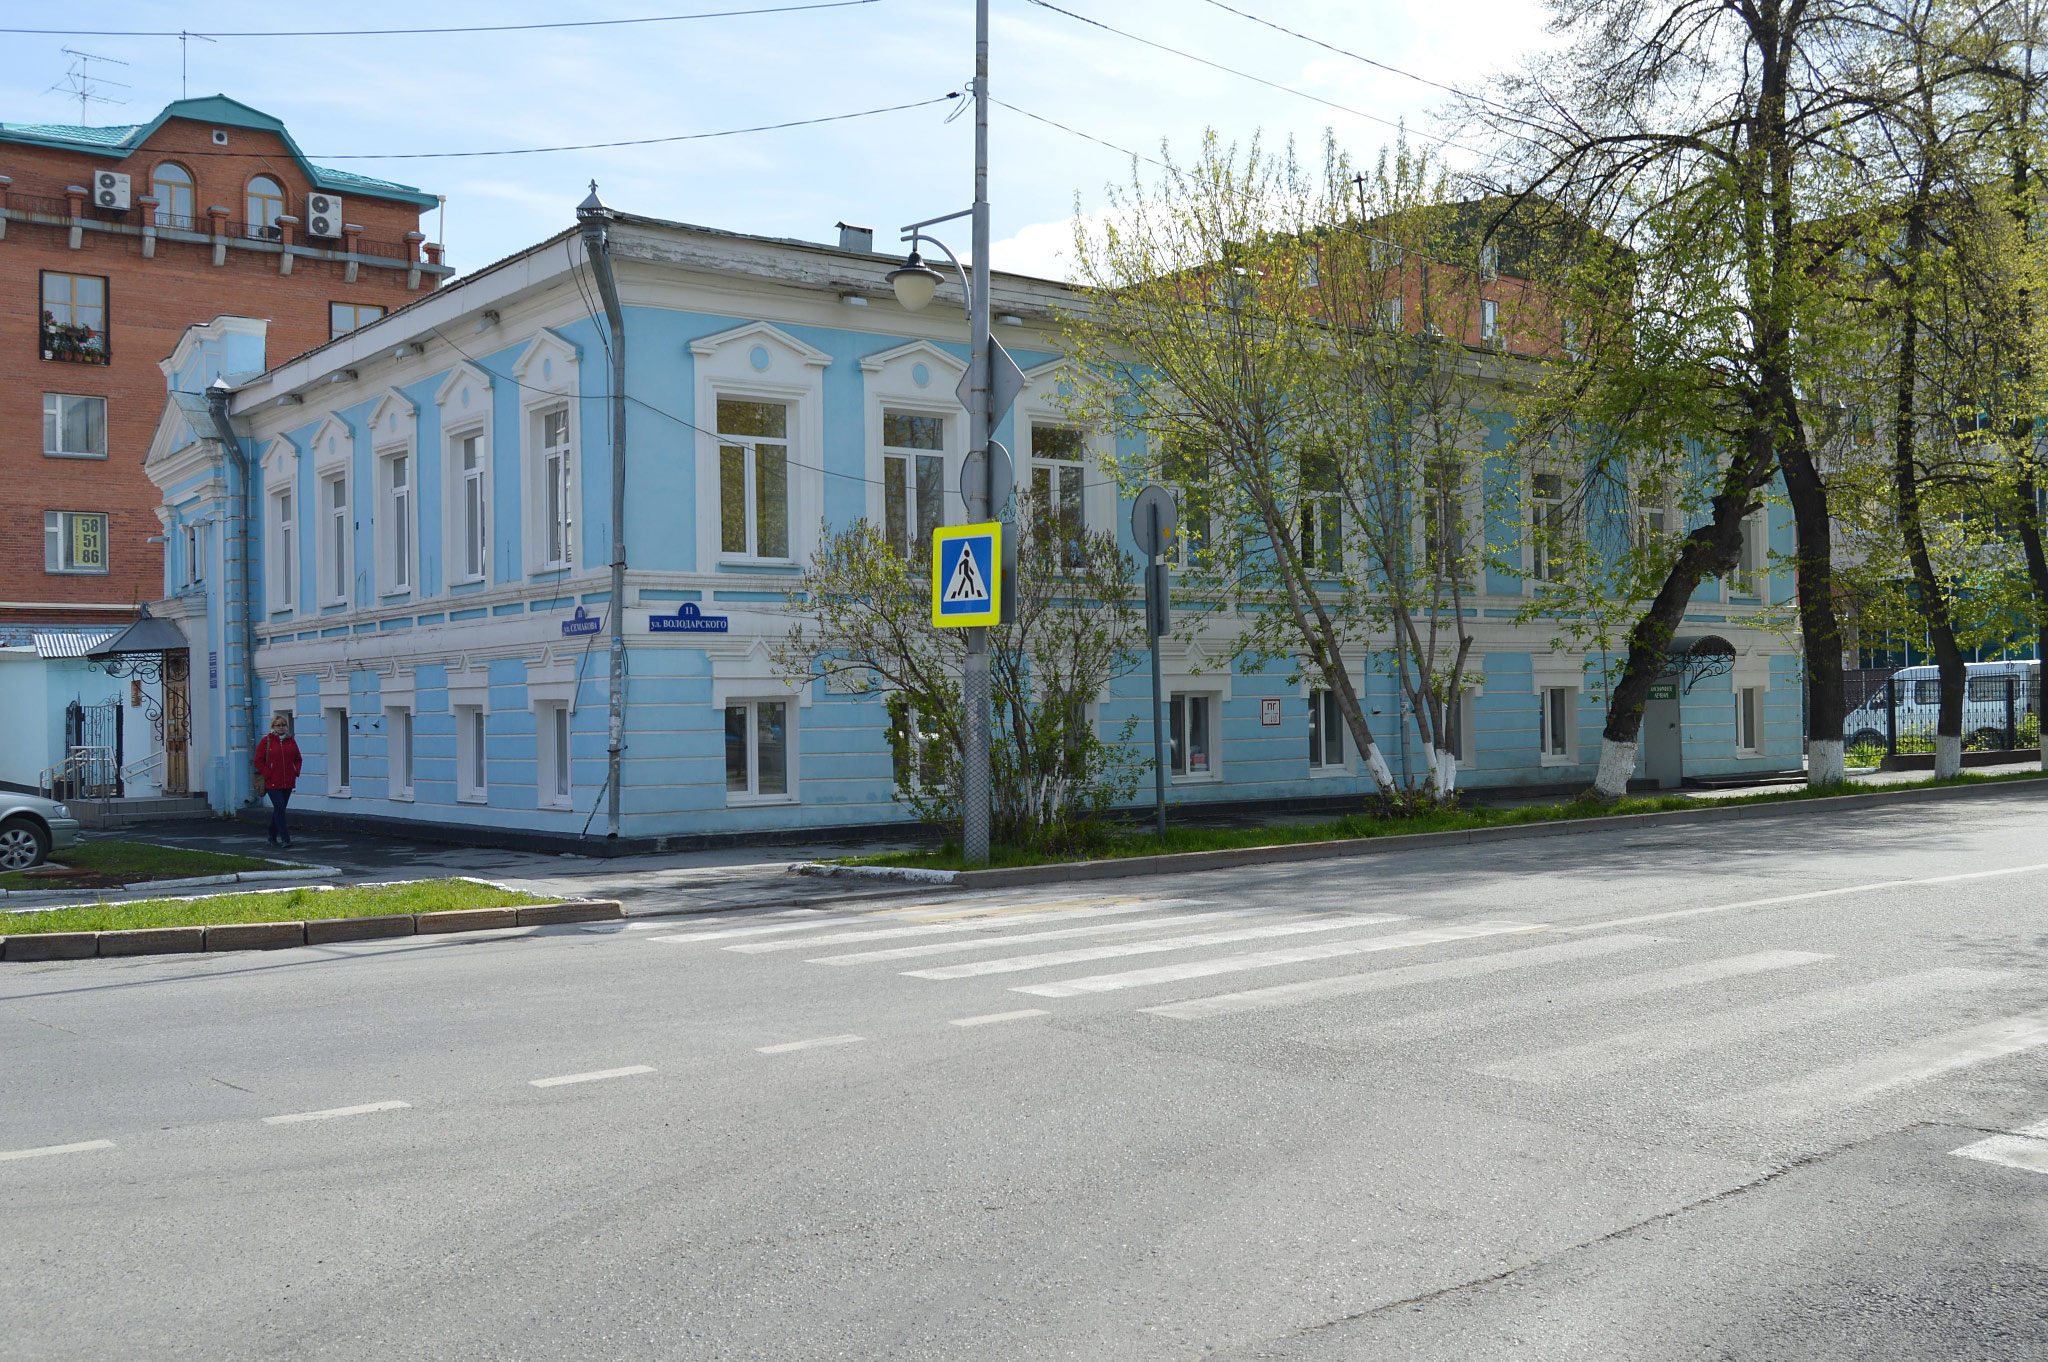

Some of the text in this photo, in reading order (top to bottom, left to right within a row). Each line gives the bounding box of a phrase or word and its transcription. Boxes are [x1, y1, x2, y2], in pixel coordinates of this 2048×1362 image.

[82, 519, 98, 532] 58
[83, 535, 97, 548] 51
[83, 550, 99, 563] 86
[685, 606, 693, 615] 11
[651, 619, 727, 630] ул. ВОЛОДАРСКОГО
[1267, 702, 1276, 711] ПГ
